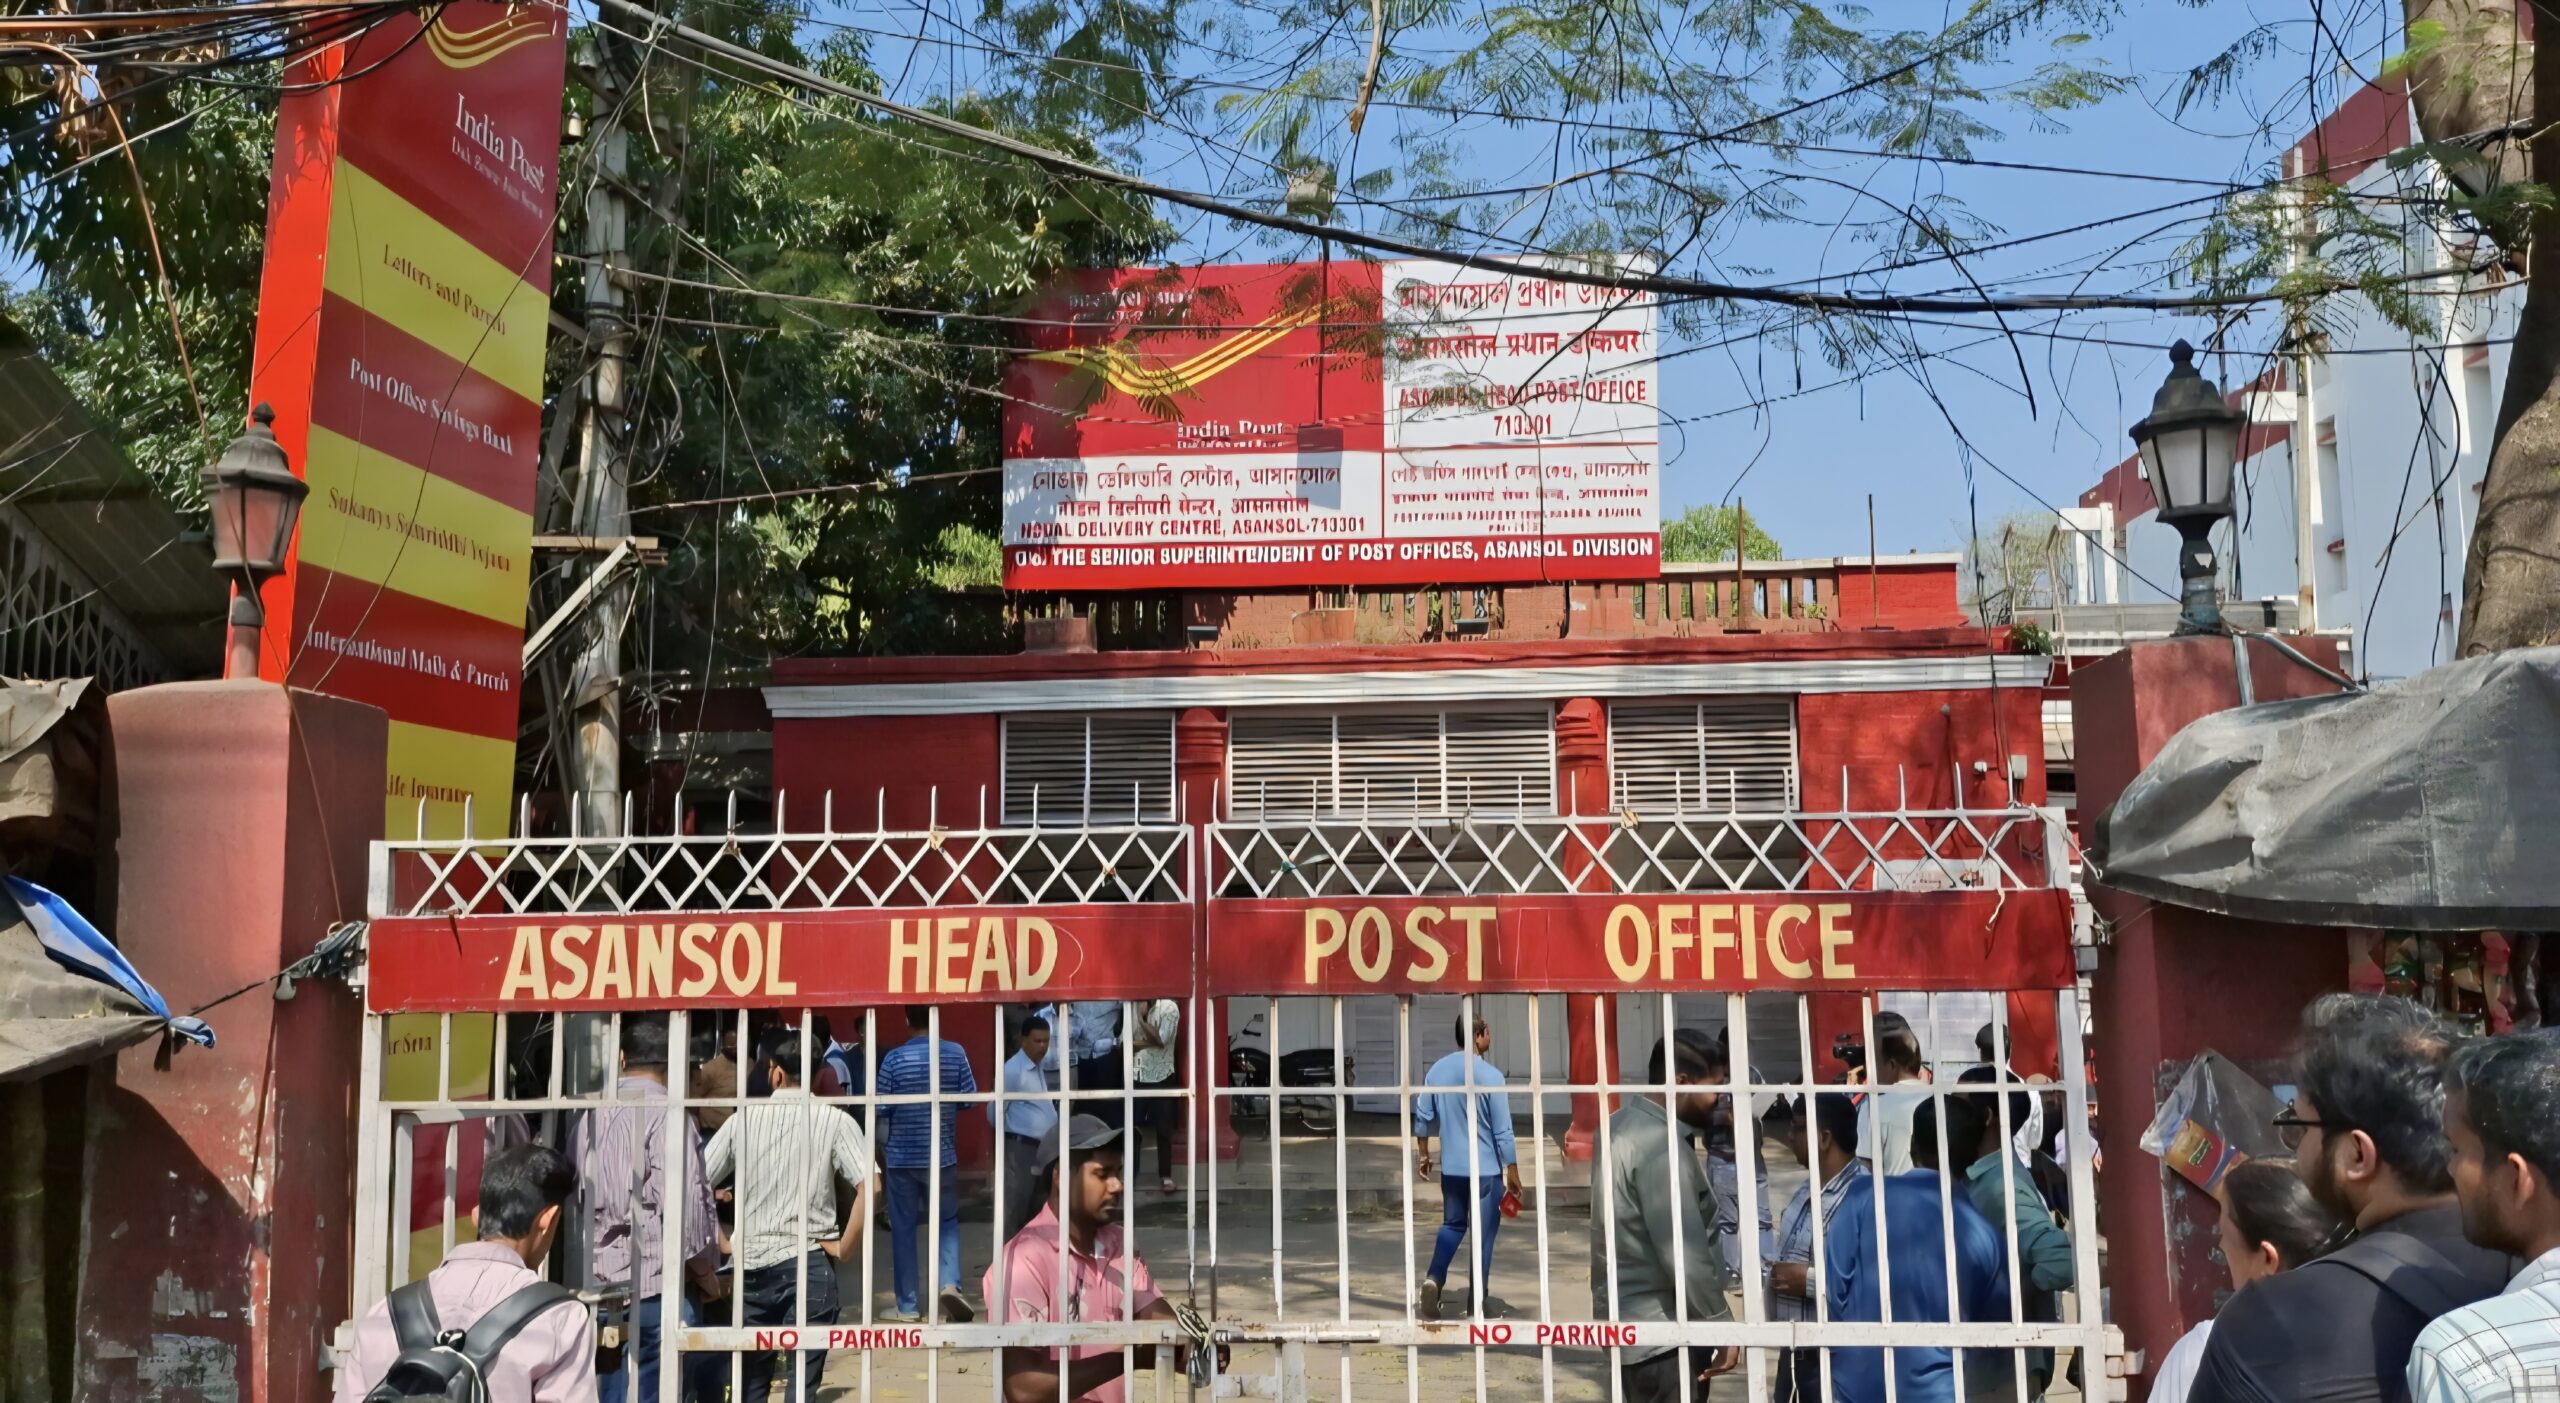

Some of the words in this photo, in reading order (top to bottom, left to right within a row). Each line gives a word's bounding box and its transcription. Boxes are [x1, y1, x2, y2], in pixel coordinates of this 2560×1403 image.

[456, 92, 504, 162] India
[510, 136, 545, 194] Post
[384, 243, 431, 290] Letters
[436, 282, 460, 307] and
[1506, 332, 1559, 357] प्रधान
[350, 358, 381, 392] Post
[386, 376, 427, 414] Office
[1536, 381, 1580, 404] POST
[1586, 380, 1645, 402] OFFICE
[1177, 420, 1230, 438] India
[1078, 520, 1154, 537] DELIVERY
[1160, 519, 1227, 538] CENTRE,
[1052, 547, 1086, 566] THE
[1090, 547, 1155, 566] SENIOR
[1160, 545, 1316, 566] SUPERINTENDENT
[1321, 544, 1344, 562] OF
[1348, 542, 1395, 562] POST
[1400, 541, 1480, 562] OFFICES,
[1484, 539, 1567, 559] ASANSOL
[1572, 537, 1653, 557] DIVISION
[501, 922, 797, 999] ASANSOL
[888, 917, 1058, 993] HEAD
[1304, 906, 1497, 984] POST
[1603, 903, 1855, 983] OFFICE
[756, 1329, 799, 1351] NO
[829, 1328, 922, 1350] PARKING
[1469, 1324, 1512, 1346] NO
[1536, 1324, 1637, 1347] PARKING
